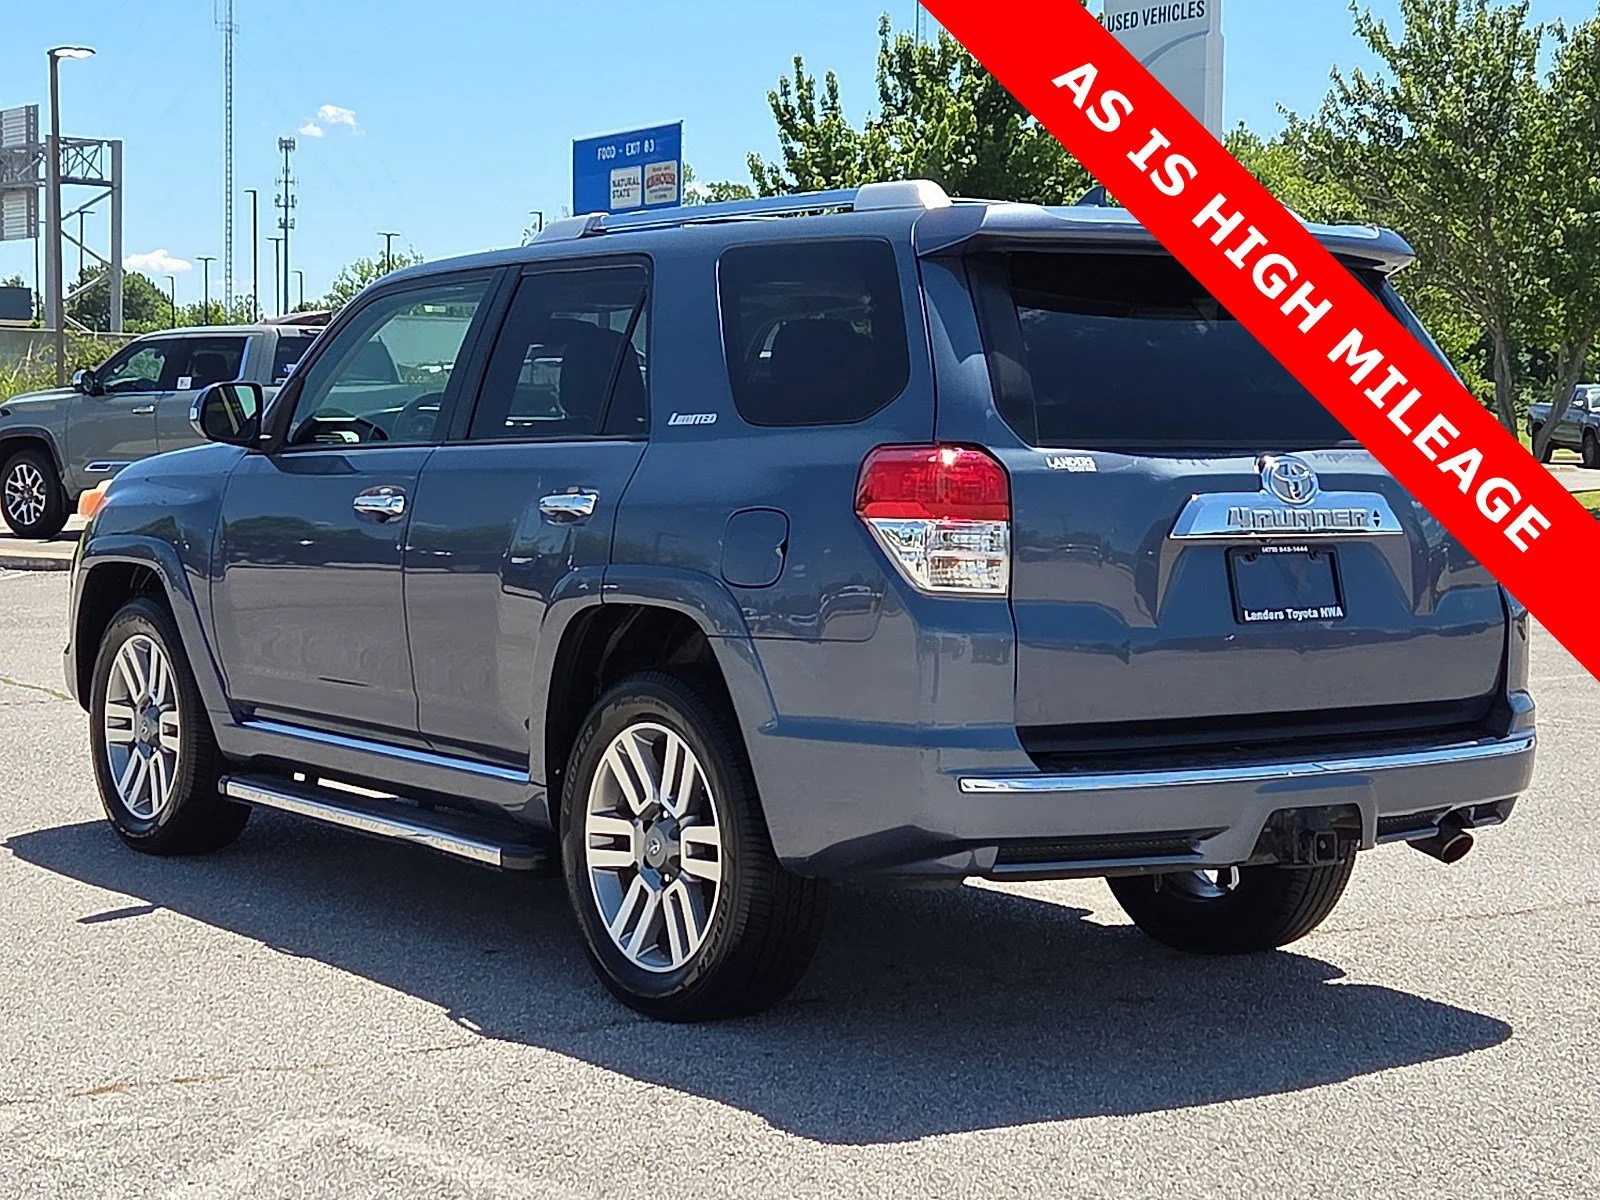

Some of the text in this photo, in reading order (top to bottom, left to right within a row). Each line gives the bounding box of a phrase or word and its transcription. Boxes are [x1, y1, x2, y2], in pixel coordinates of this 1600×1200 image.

[1107, 1, 1205, 32] USED VEHICLES
[597, 145, 616, 160] FOOD
[626, 141, 640, 156] EXIT
[612, 176, 640, 188] NATURAL
[612, 187, 631, 199] STATE
[1046, 456, 1096, 468] LANDERS
[1227, 507, 1369, 528] 4RUNNER
[1244, 606, 1343, 621] Landers Toyota NWA
